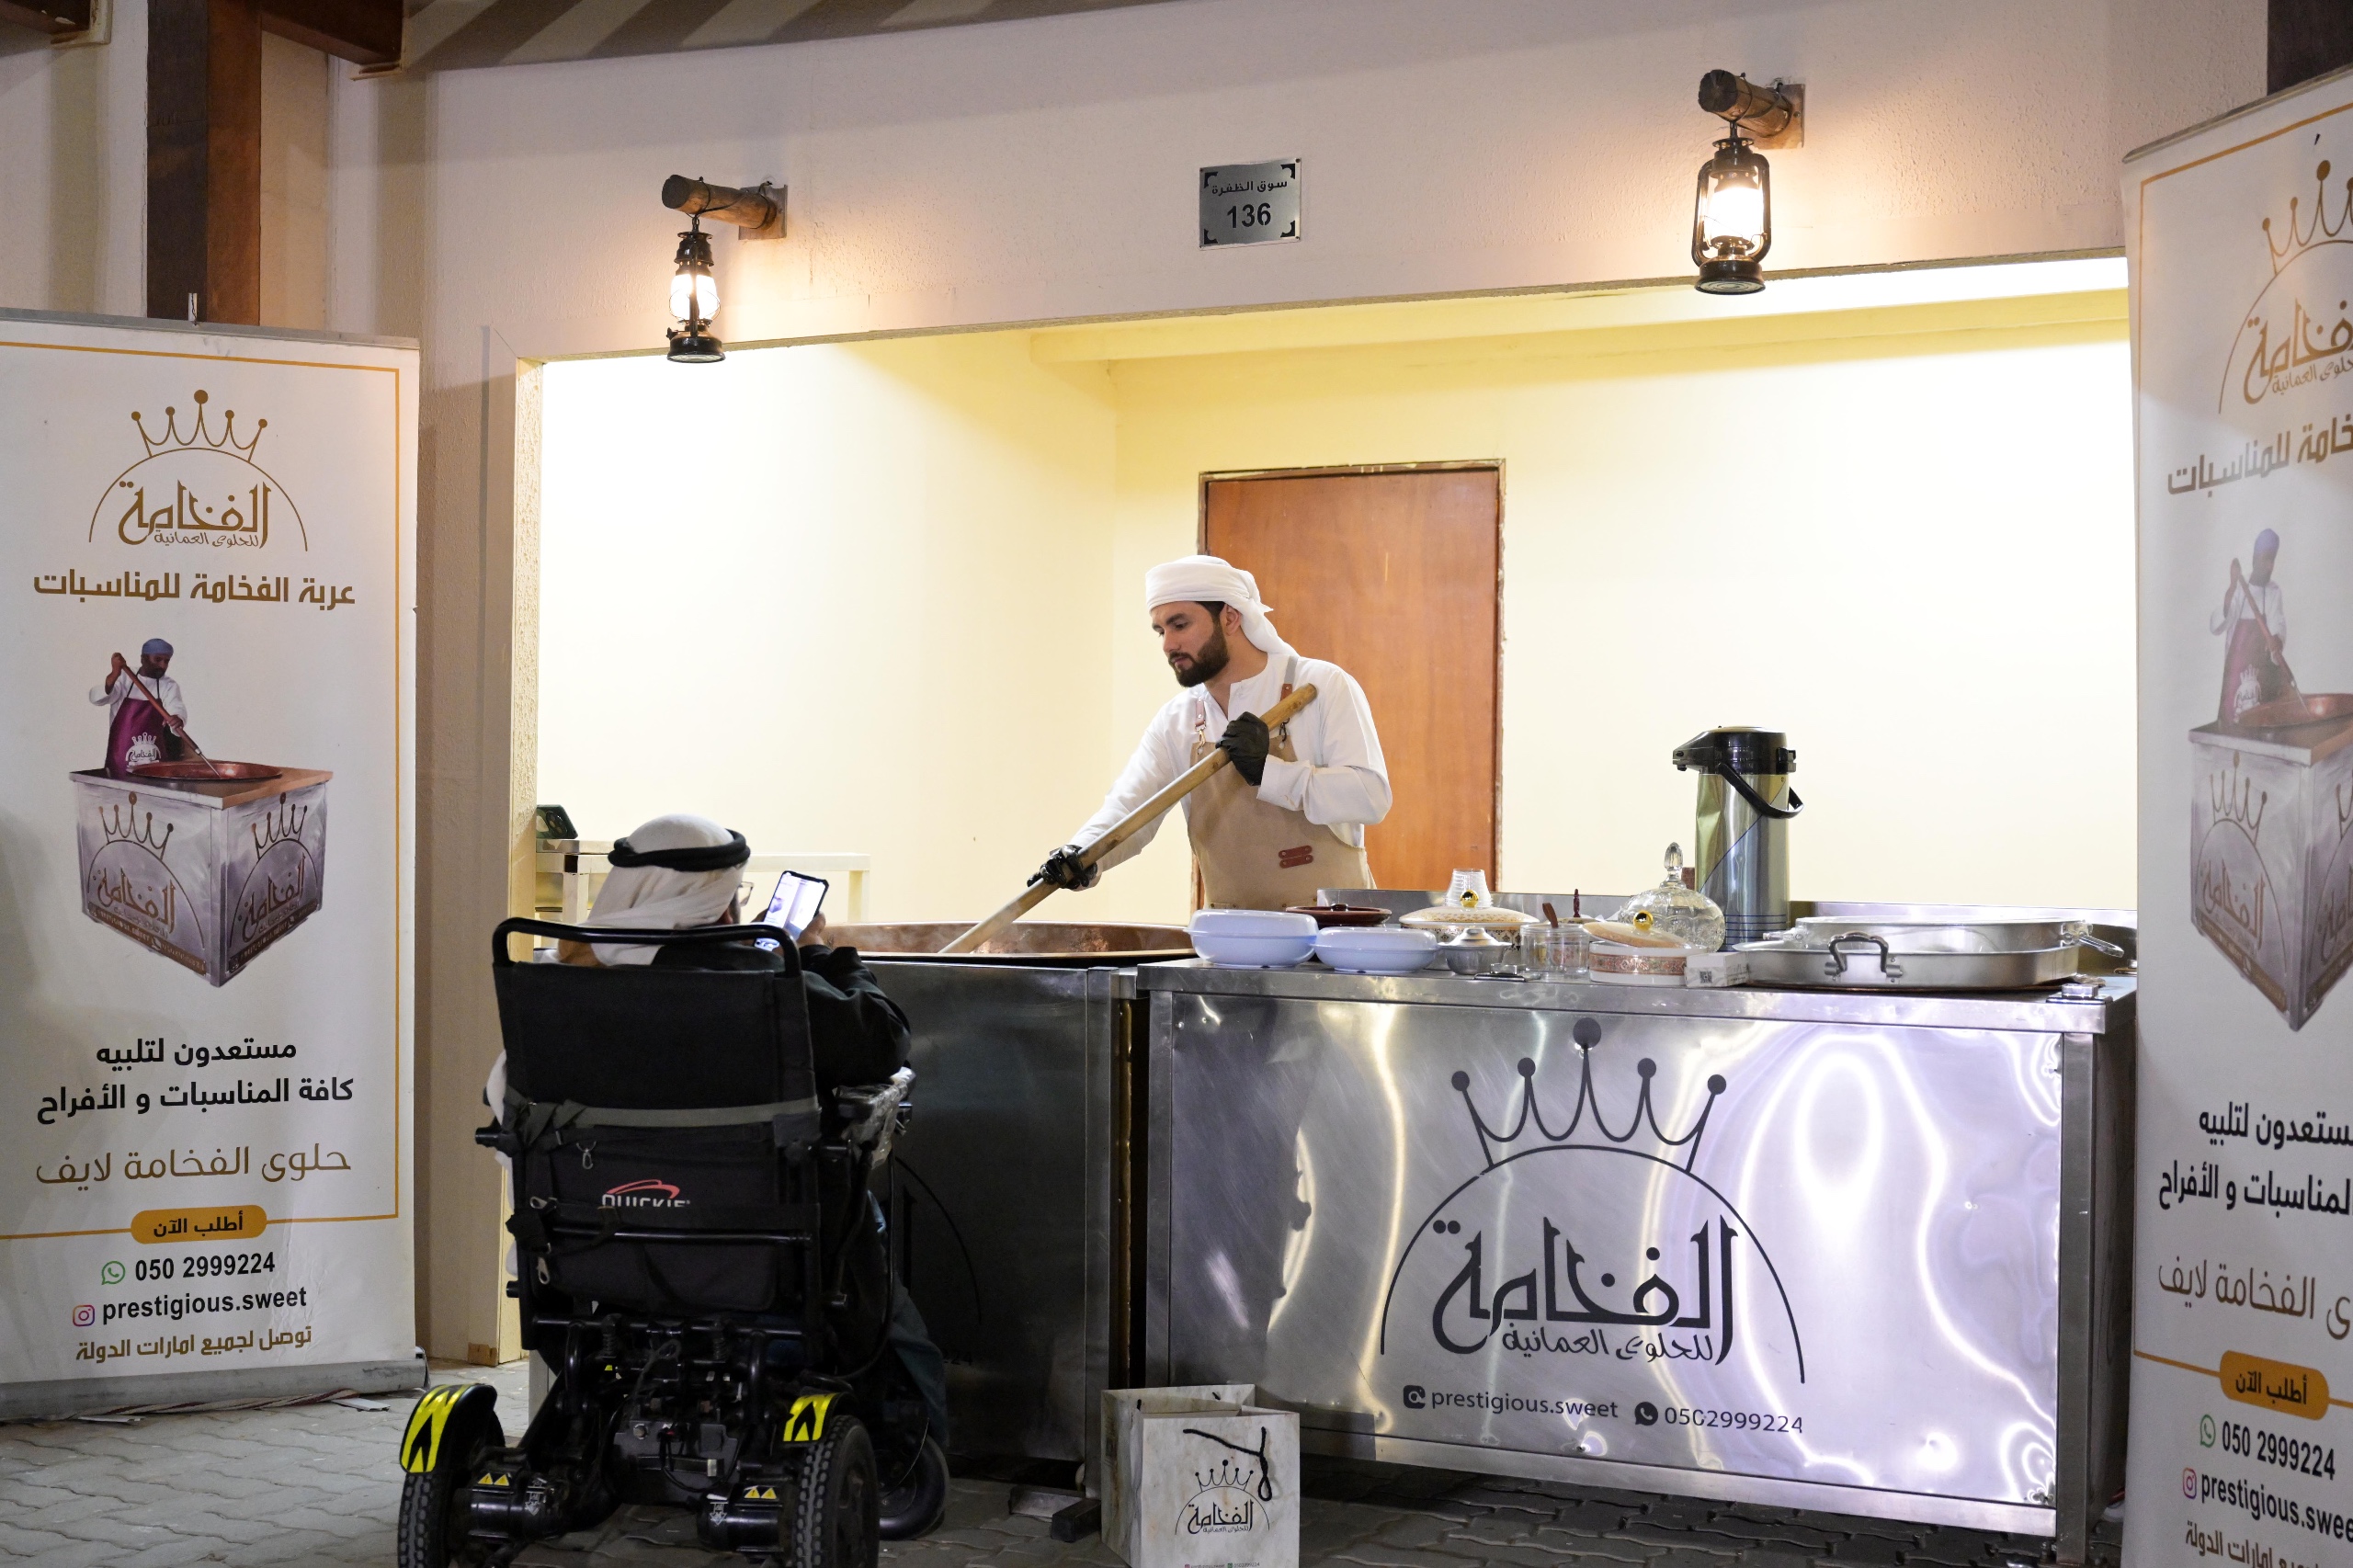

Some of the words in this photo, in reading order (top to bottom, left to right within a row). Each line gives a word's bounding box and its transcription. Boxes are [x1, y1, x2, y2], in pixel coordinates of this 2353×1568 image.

[1211, 181, 1254, 197] الظفرة
[1256, 180, 1288, 193] سوق
[1226, 202, 1272, 229] 136
[2167, 430, 2291, 497] للمناسبات
[118, 479, 272, 550] الفخامة
[153, 529, 210, 547] العمانية
[211, 533, 259, 549] للحلوى
[33, 568, 180, 602] للمناسبات
[190, 572, 289, 604] الفخامة
[299, 577, 356, 610] عربة
[96, 1039, 165, 1072] لتلبيه
[174, 1037, 298, 1068] مستعدون
[36, 1083, 126, 1124] الأفراح
[135, 1090, 150, 1113] و
[159, 1078, 290, 1113] المناسبات
[298, 1077, 354, 1102] كافة
[2199, 1101, 2249, 1146] لتلبيه
[2256, 1111, 2353, 1150] ستعدون
[36, 1152, 112, 1191] لايف
[124, 1146, 249, 1179] الفخامة
[261, 1142, 352, 1182] حلوى
[2159, 1160, 2219, 1210] الأفراح
[2226, 1181, 2237, 1210] و
[2244, 1170, 2353, 1219] لمناسبات
[153, 1218, 188, 1238] الآن
[193, 1210, 244, 1237] أطلب
[134, 1258, 175, 1281] 050
[182, 1252, 276, 1278] 2999224
[2158, 1256, 2208, 1309] لايف
[102, 1287, 308, 1324] prestigious.sweet
[1432, 1214, 1739, 1365] الفخامة
[2216, 1263, 2316, 1320] الفخامة
[75, 1339, 131, 1363] الدولة
[136, 1334, 195, 1356] امارات
[200, 1331, 255, 1356] لجميع
[259, 1326, 313, 1351] توصل
[1502, 1323, 1609, 1358] العمانية
[1616, 1333, 1715, 1363] للحلوى
[2235, 1370, 2262, 1394] الآن
[2267, 1373, 2308, 1405] أطلب
[1431, 1392, 1619, 1418] prestigious.sweet
[2222, 1420, 2251, 1458] 050
[2256, 1430, 2336, 1482] 2999224
[1187, 1498, 1254, 1534] الفخامة
[2201, 1472, 2353, 1543] prestigious.swee
[2185, 1519, 2224, 1557] الدولة
